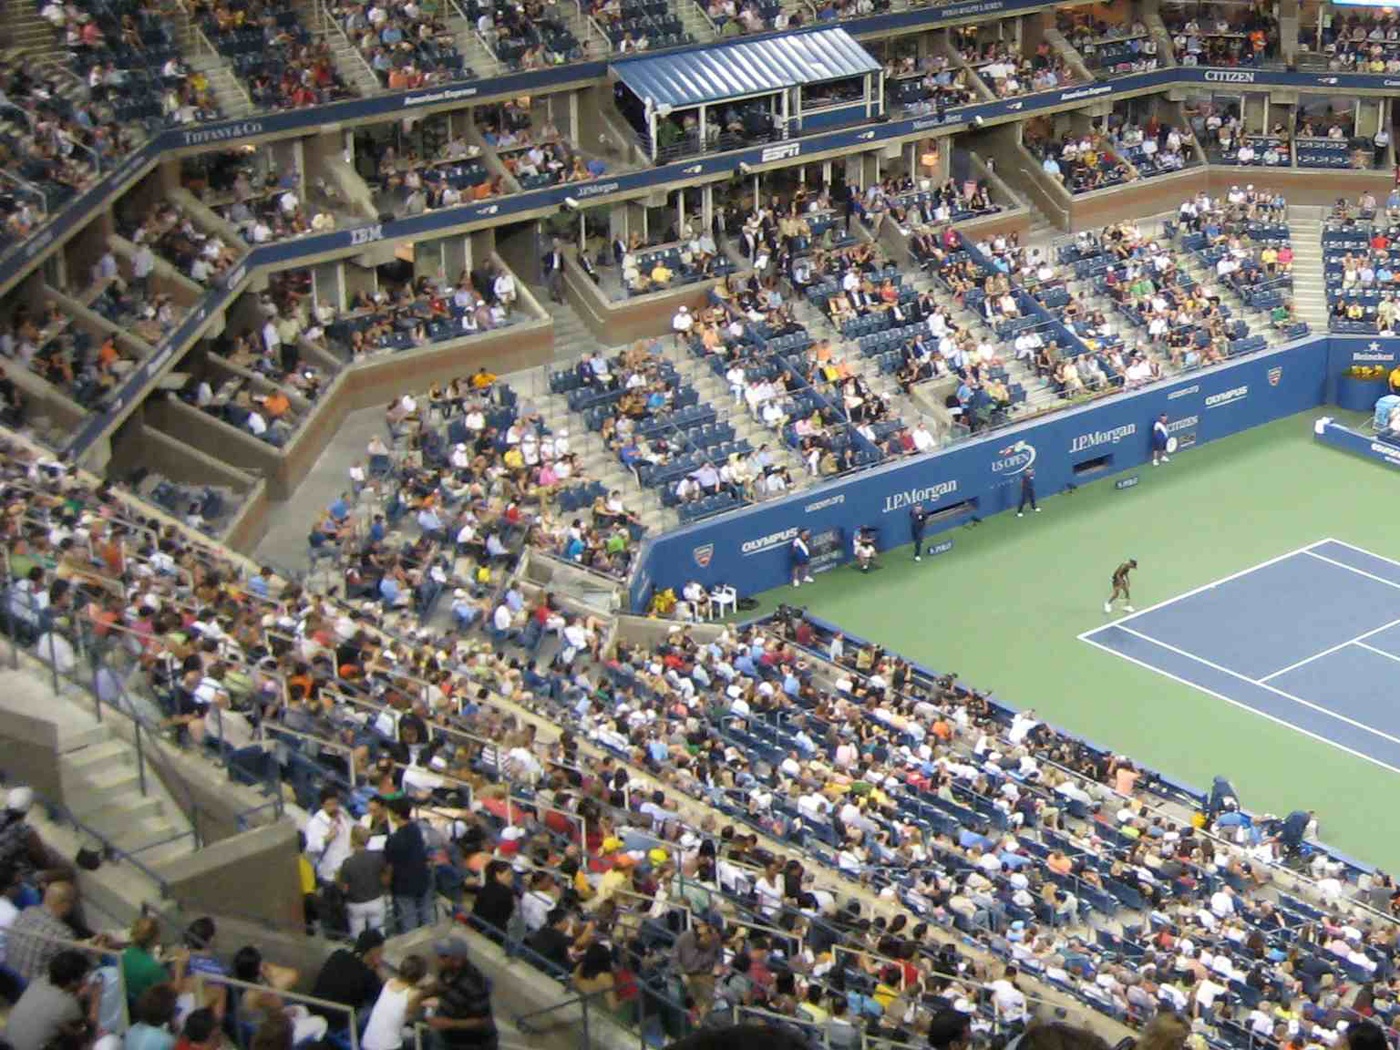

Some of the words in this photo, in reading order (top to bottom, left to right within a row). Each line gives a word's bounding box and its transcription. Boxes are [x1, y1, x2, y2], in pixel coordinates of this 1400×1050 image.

[1204, 71, 1254, 82] CITIZEN
[762, 143, 800, 162] ESPN
[351, 225, 382, 245] IBM
[1352, 352, 1395, 361] Heineken
[1205, 385, 1248, 406] OLYMPUS
[992, 460, 1004, 472] US
[1004, 452, 1030, 468] OPEN
[742, 526, 800, 552] OLYMPUS
